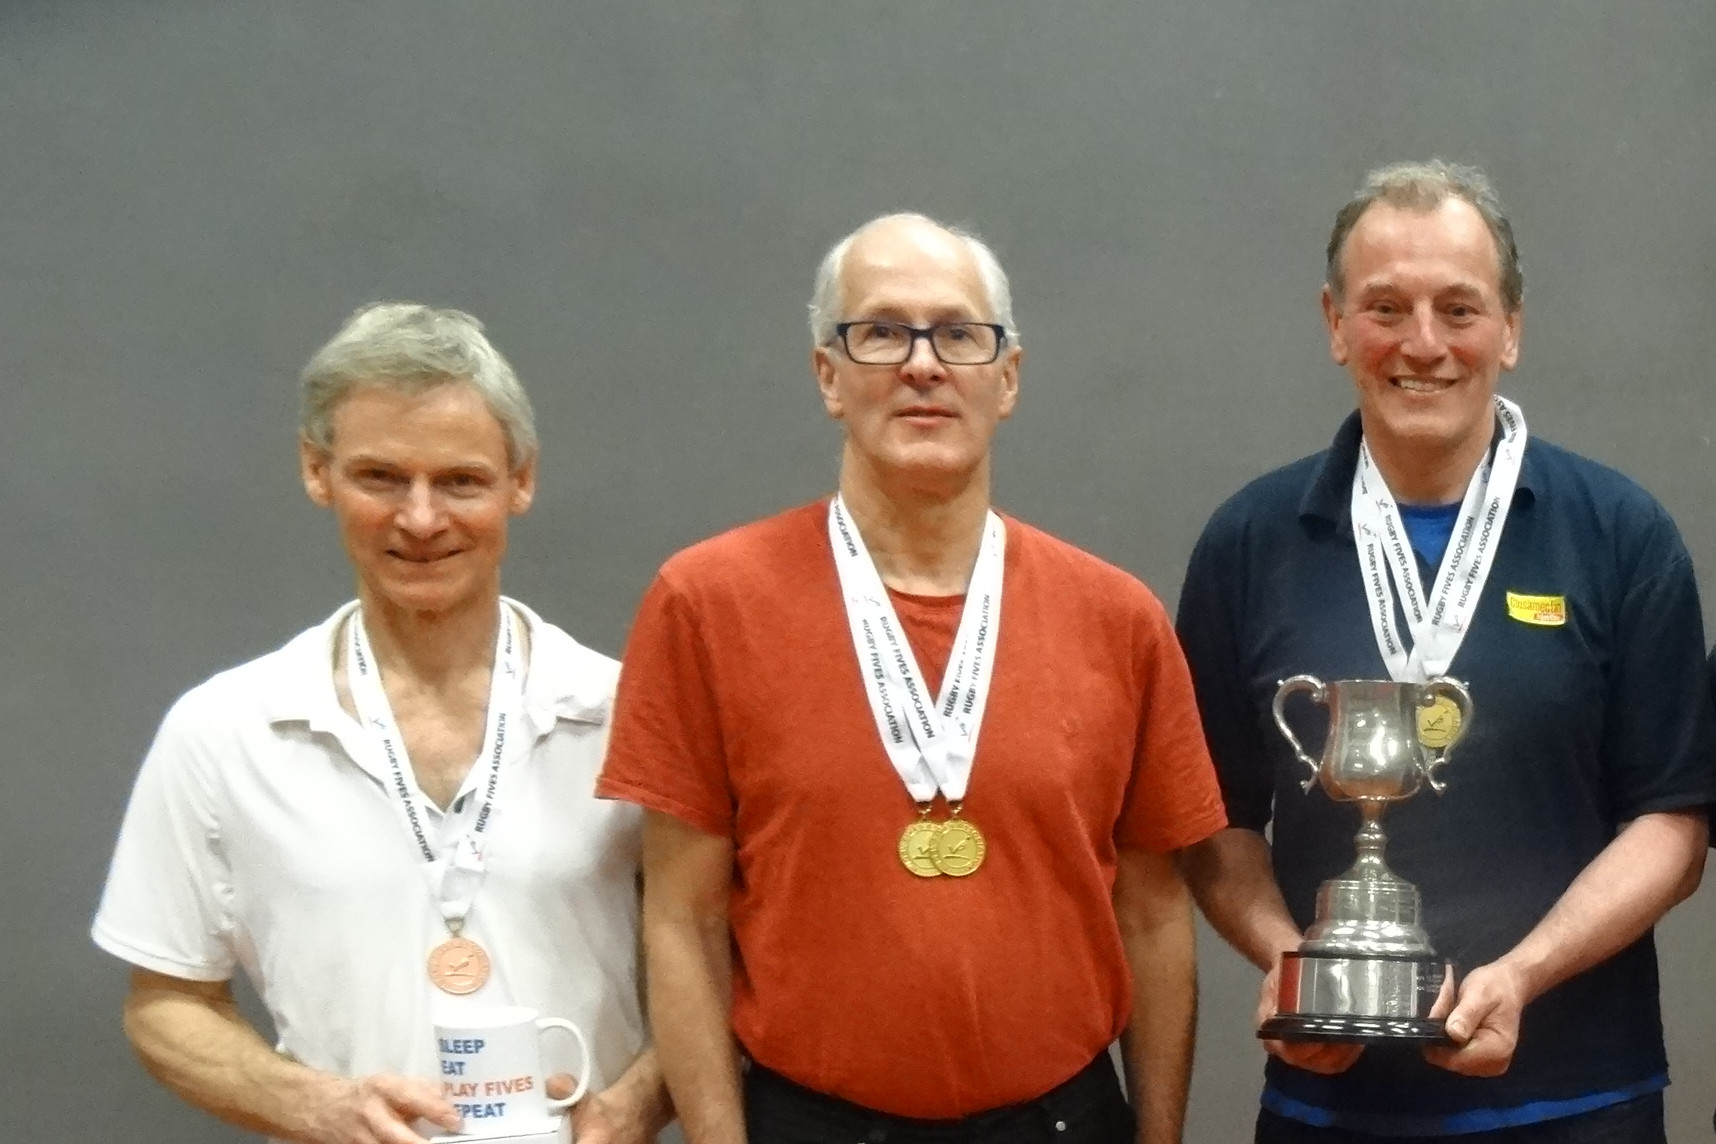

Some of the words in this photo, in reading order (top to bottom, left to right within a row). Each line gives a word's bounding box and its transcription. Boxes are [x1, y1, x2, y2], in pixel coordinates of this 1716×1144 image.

[1367, 543, 1378, 571] RUGBY
[1385, 514, 1398, 541] RUGBY
[1393, 542, 1407, 566] FIVES
[1402, 567, 1423, 624] ASSOCIATION
[1432, 595, 1447, 626] RUGBY
[1442, 571, 1455, 595] FIVES
[1450, 515, 1475, 571] ASSOCIATION
[1458, 577, 1473, 608] RUGBY
[1468, 555, 1483, 579] FIVES
[1477, 495, 1500, 554] ASSOCIATION
[1372, 572, 1383, 598] FIVES
[1378, 599, 1397, 655] ASSOCIATION
[963, 682, 976, 714] RUGBY
[976, 594, 990, 654] ASSOCIATION
[863, 619, 877, 650] RUGBY
[870, 652, 884, 679] FIVES
[877, 681, 904, 744] ASSOCIATION
[880, 616, 898, 646] RUGBY
[893, 648, 910, 675] FIVES
[904, 677, 936, 739] ASSOCIATION
[943, 685, 960, 717] RUGBY
[384, 739, 400, 770] RUGBY
[486, 773, 498, 800] FIVES
[441, 1060, 466, 1075] EAT
[485, 1076, 533, 1096] FIVES
